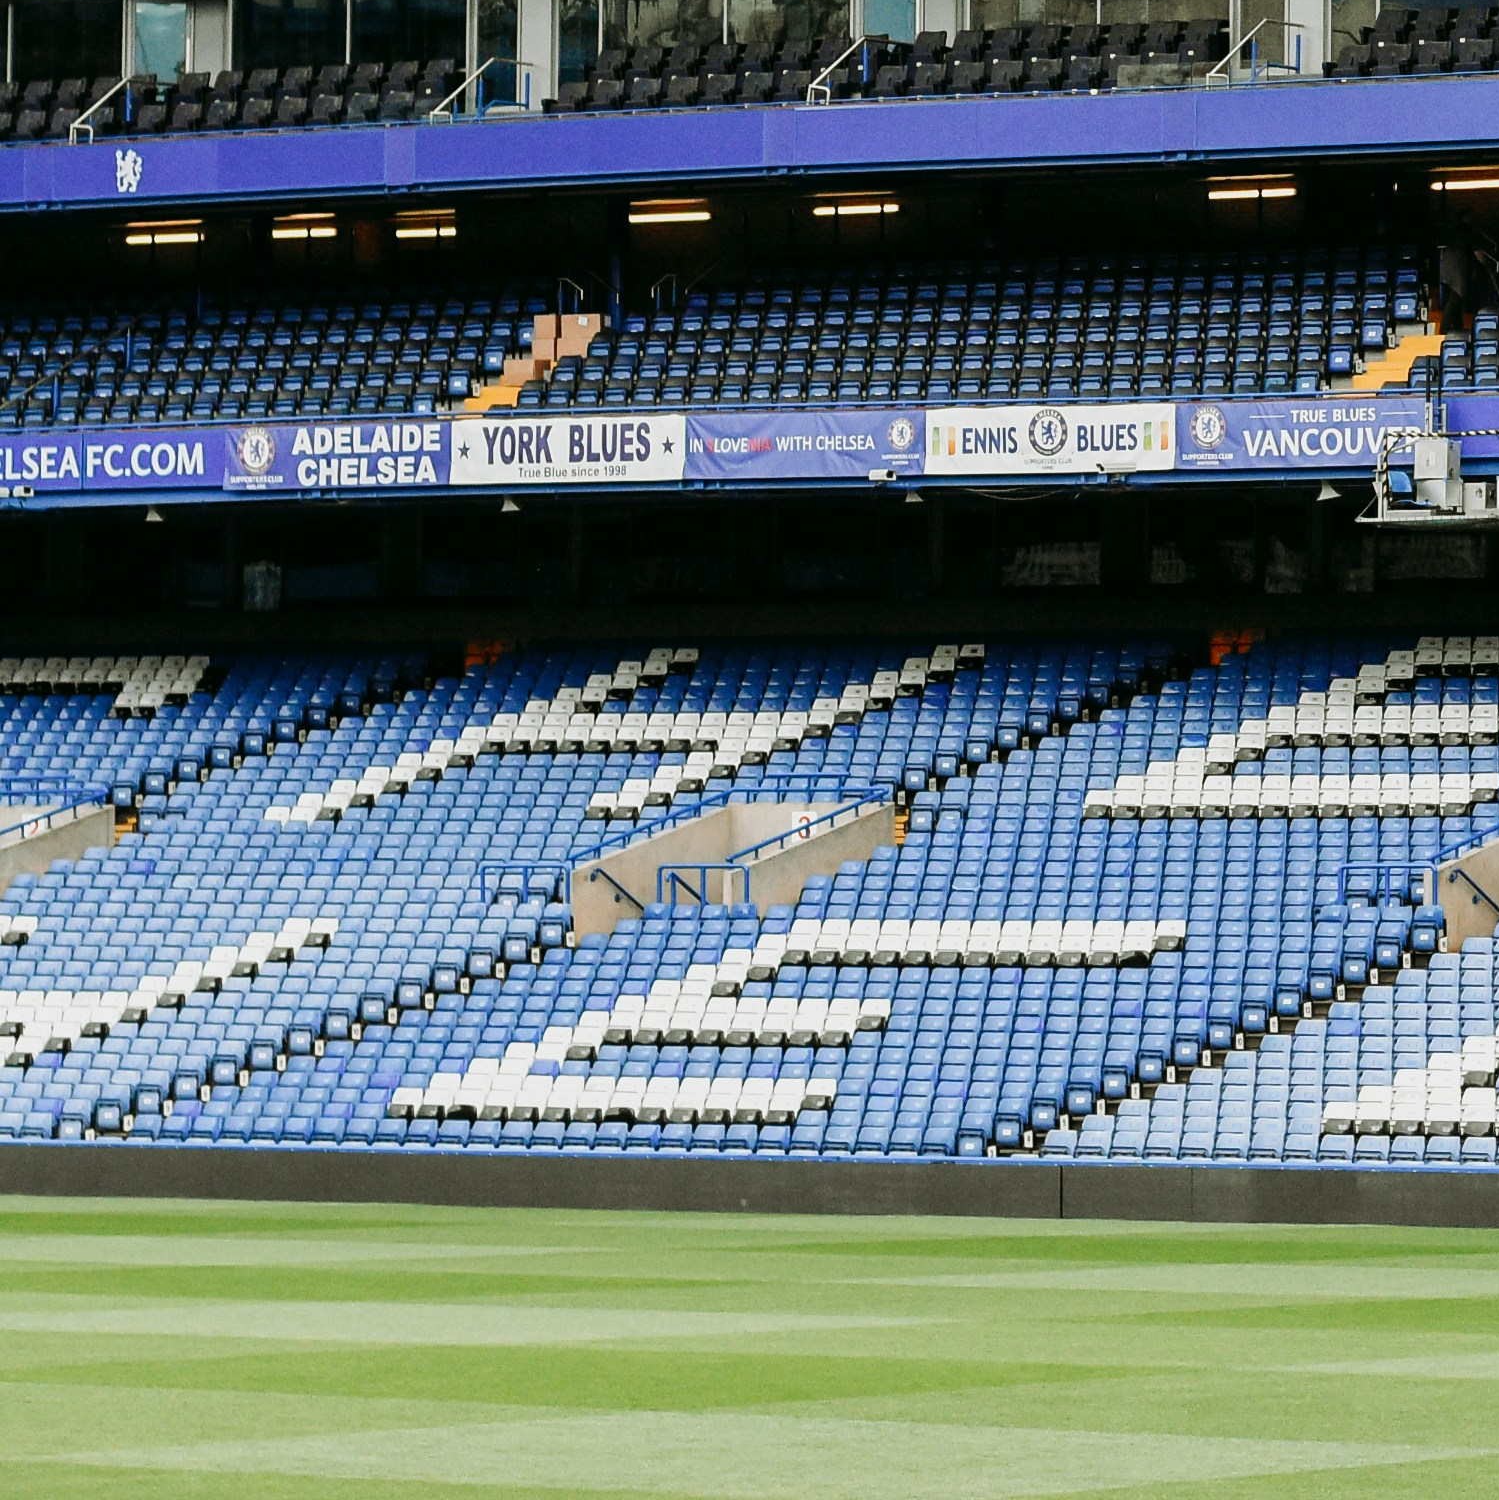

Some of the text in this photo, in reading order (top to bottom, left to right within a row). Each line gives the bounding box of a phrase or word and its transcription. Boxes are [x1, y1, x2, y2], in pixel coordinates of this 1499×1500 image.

[1290, 407, 1376, 423] TRUE BLUES
[292, 424, 441, 455] ADELAIDE
[482, 422, 651, 465] YORK BLUES
[689, 435, 876, 453] IN SLOVENIA WITH CHELSEA
[962, 424, 1138, 455] ENNIS BLUES
[0, 442, 204, 481] LSEAFC.COM
[297, 455, 437, 486] CHELSEA
[518, 465, 627, 478] True Blue since 1998
[798, 816, 812, 839] 3
